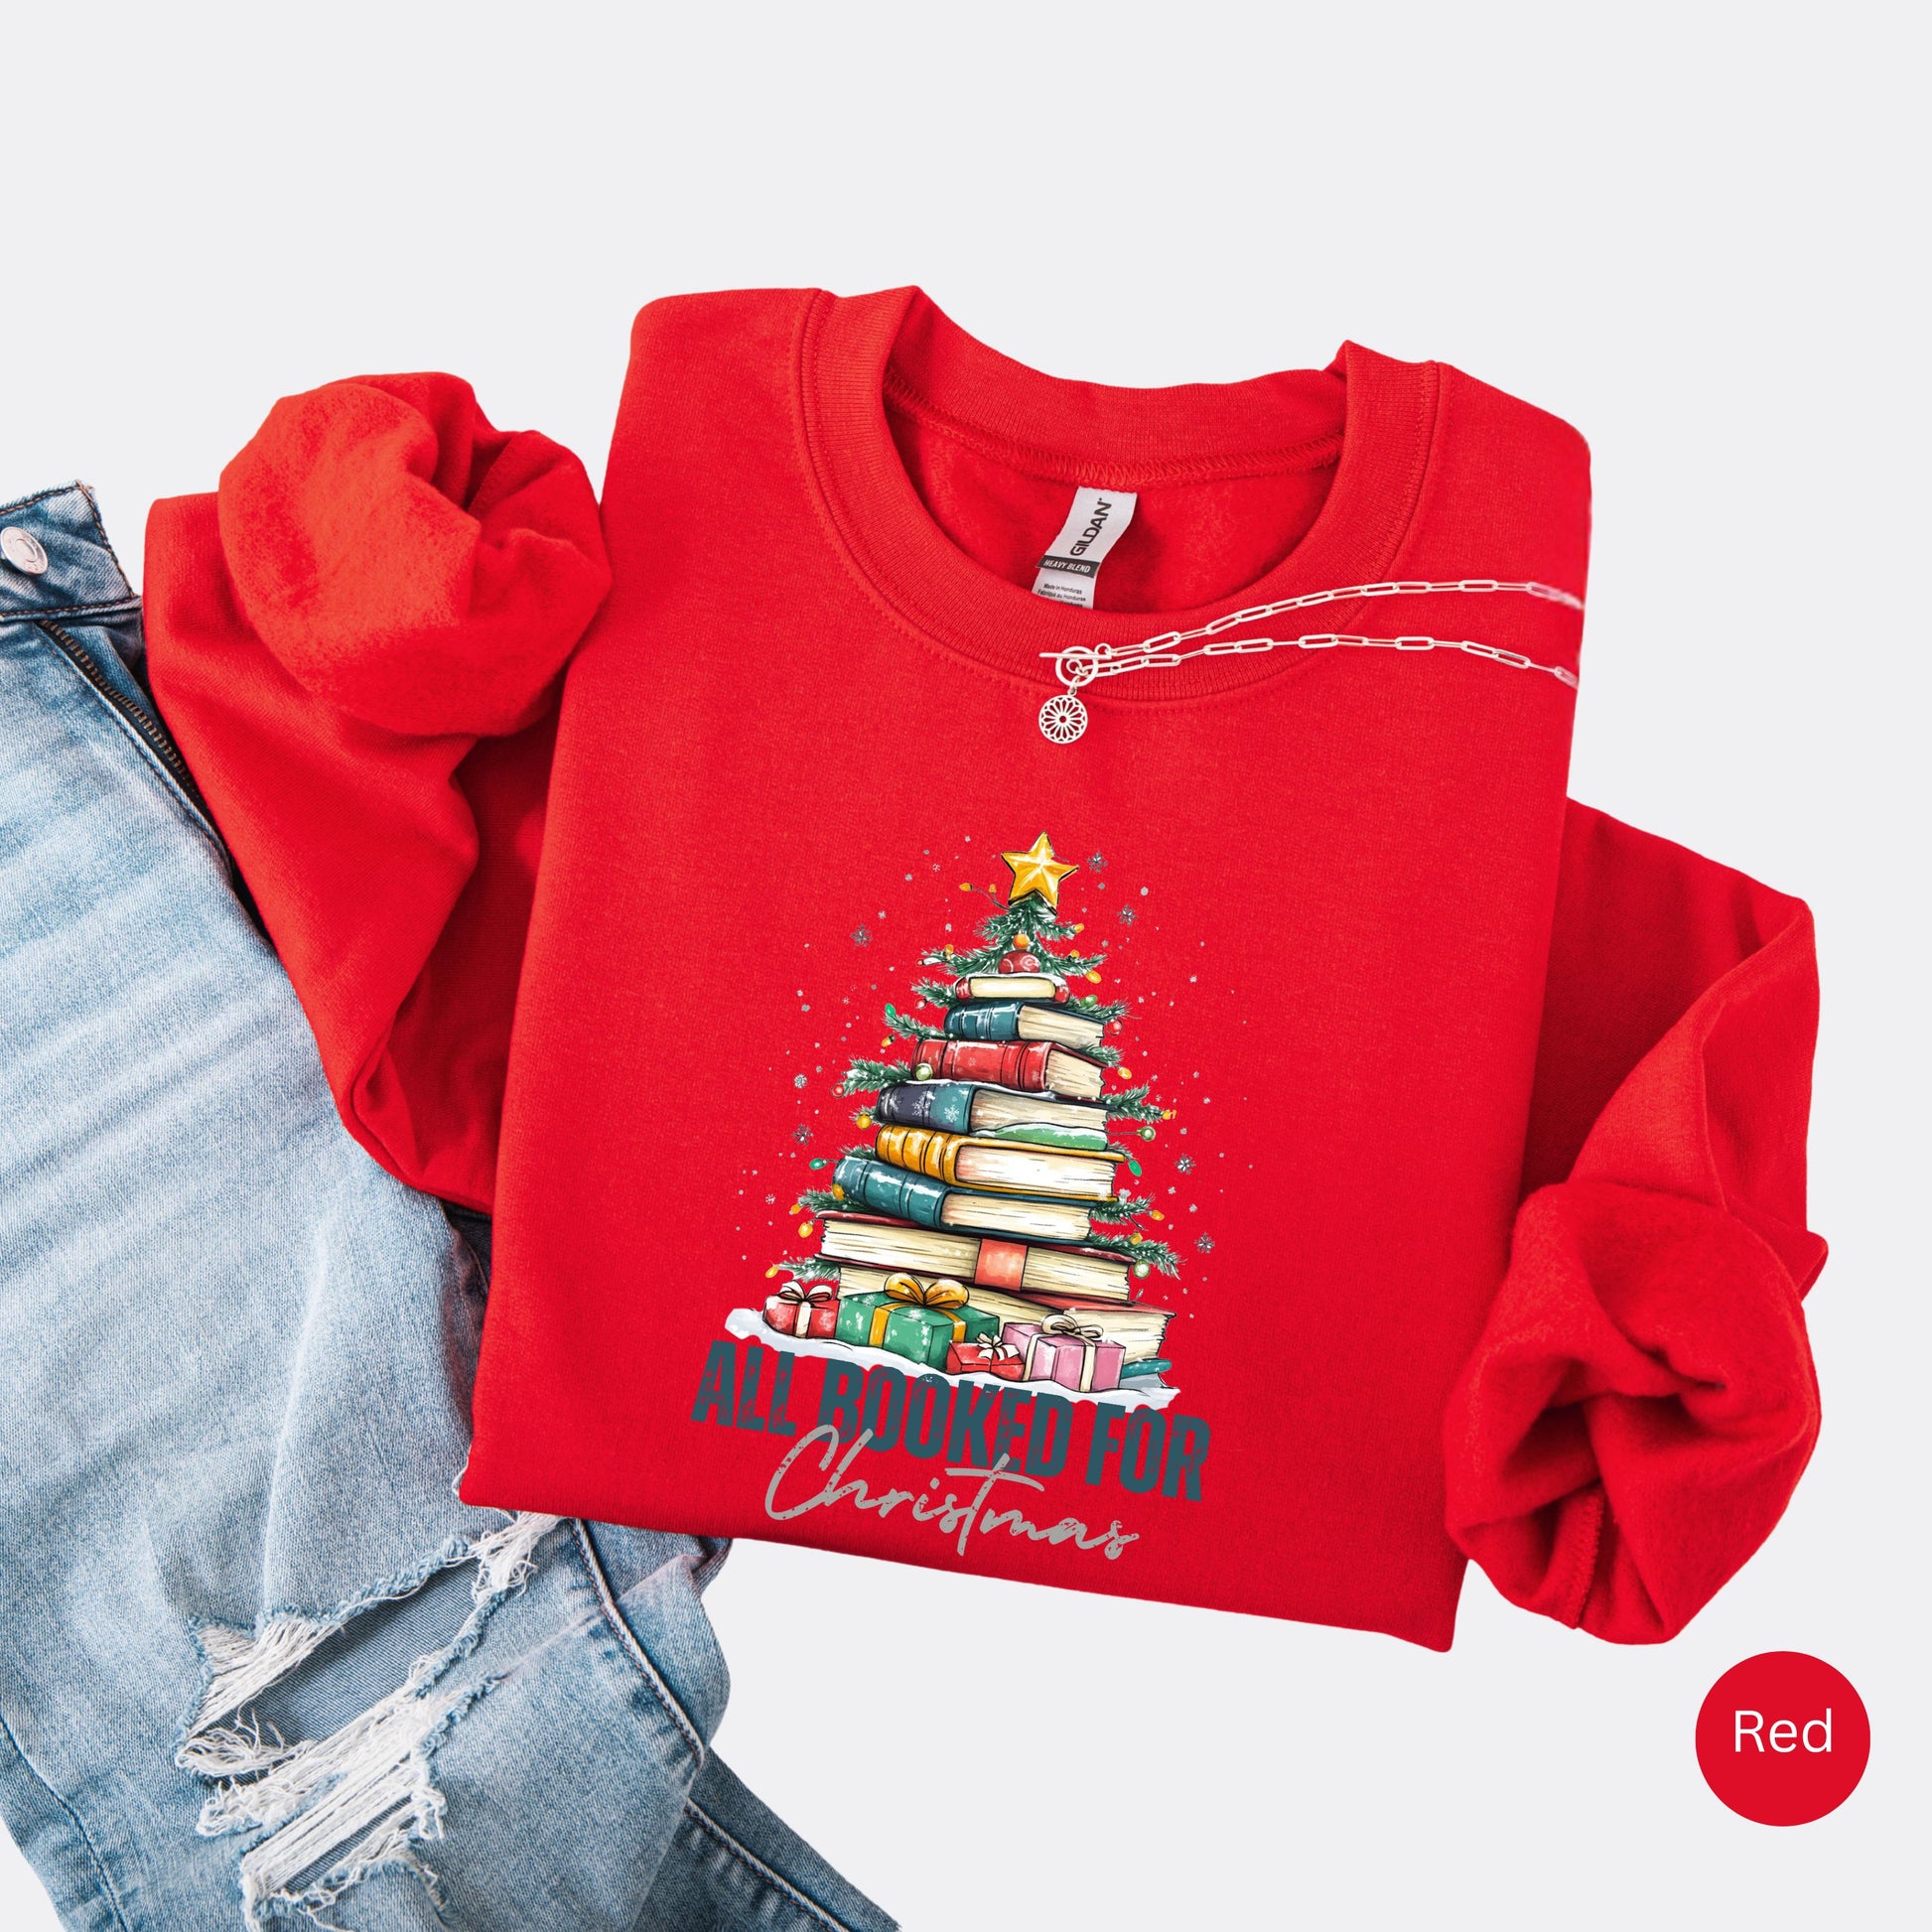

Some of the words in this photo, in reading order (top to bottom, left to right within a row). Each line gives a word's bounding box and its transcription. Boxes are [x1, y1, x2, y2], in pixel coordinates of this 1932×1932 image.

[1043, 559, 1067, 569] HEAVY
[1067, 562, 1091, 573] BLEND
[1069, 500, 1112, 556] GILDAN
[691, 1340, 796, 1437] ALL
[817, 1355, 1074, 1479] BOOKED
[1085, 1402, 1211, 1502] FOR
[764, 1424, 1140, 1560] Christmas
